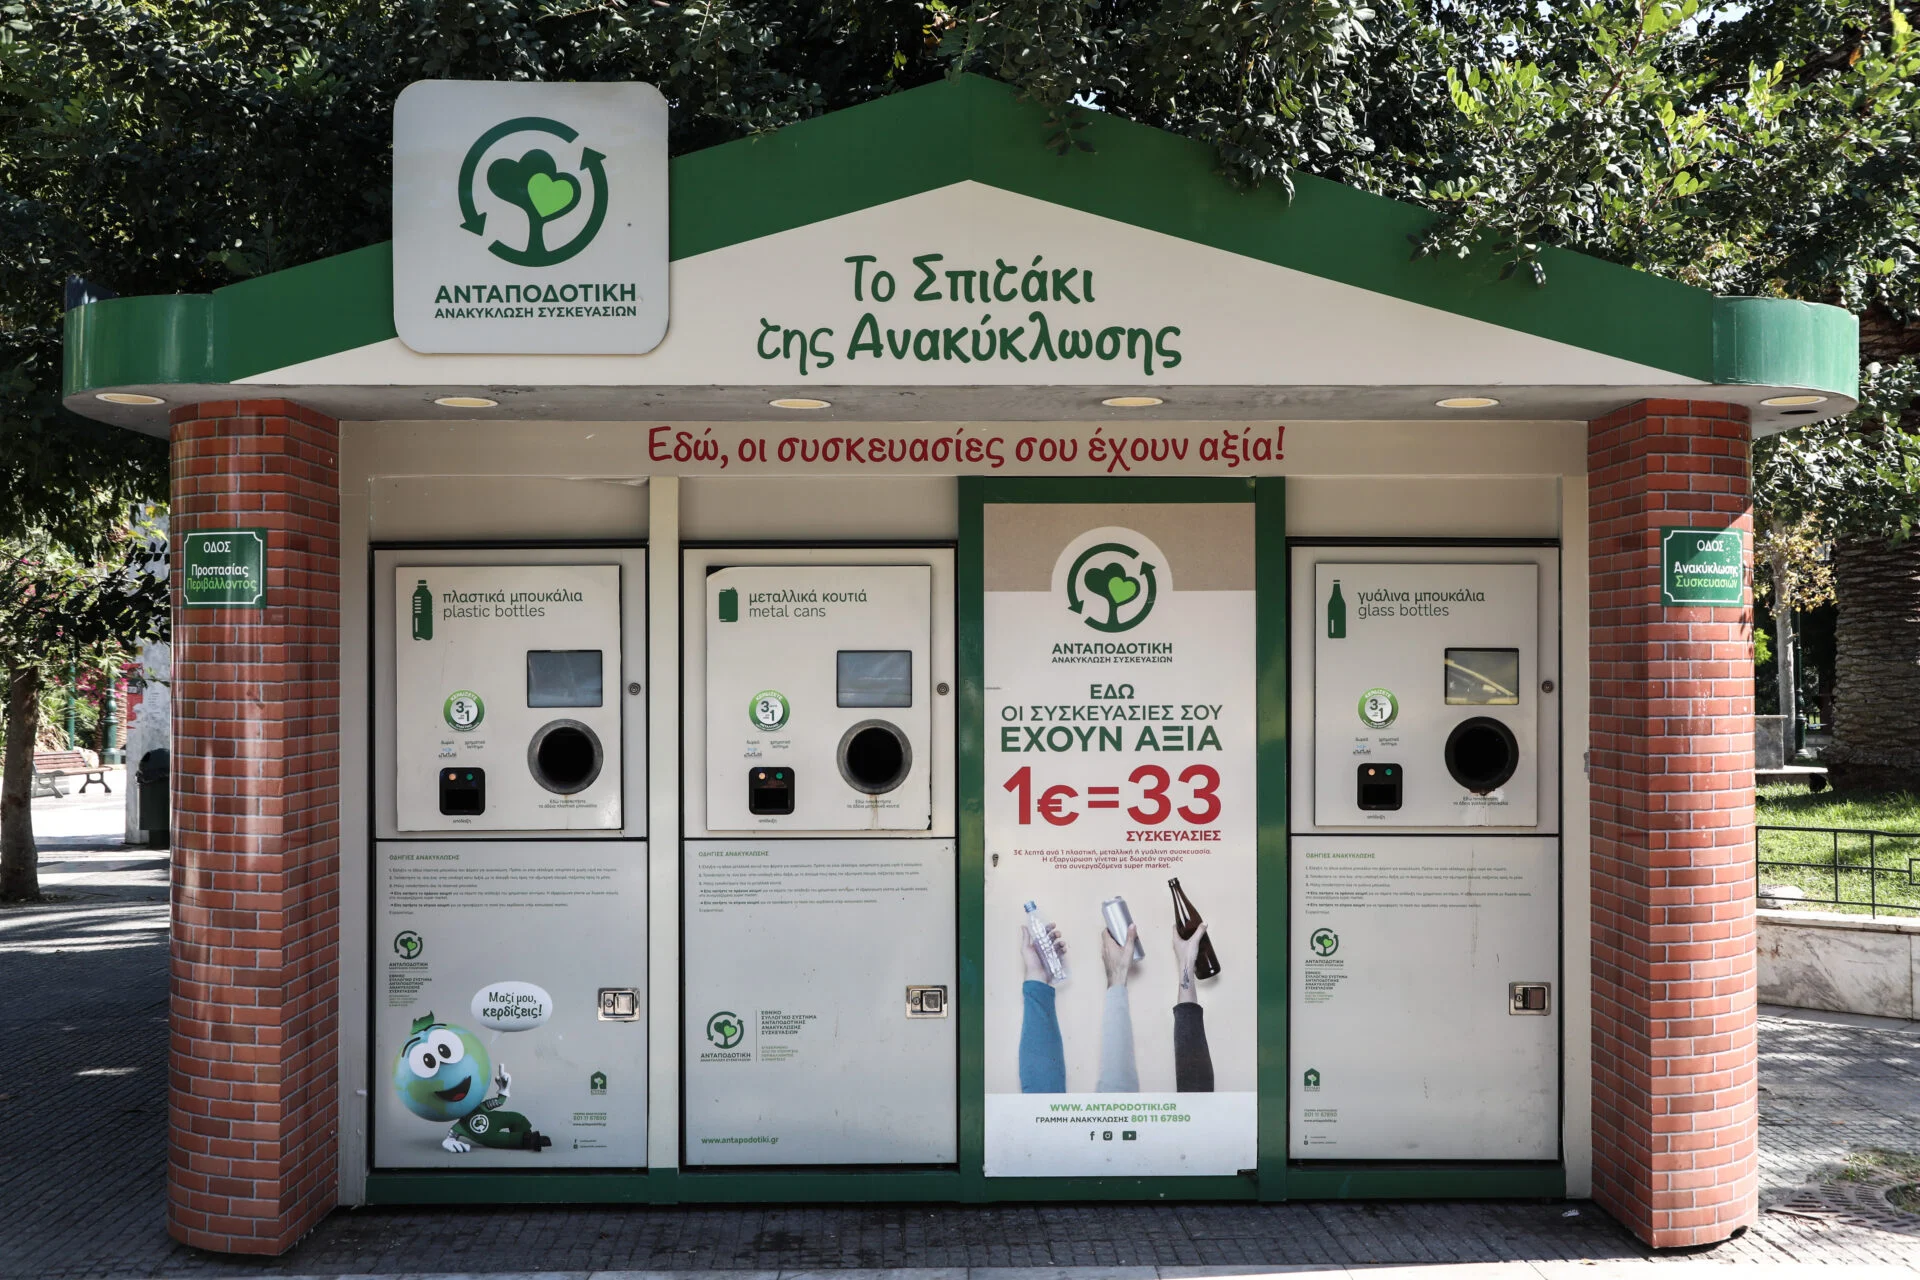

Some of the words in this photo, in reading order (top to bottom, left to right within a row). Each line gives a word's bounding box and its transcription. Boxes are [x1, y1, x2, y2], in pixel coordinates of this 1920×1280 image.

[845, 255, 895, 302] Το
[913, 253, 1095, 304] Σπιτάκι
[434, 284, 636, 304] ΑΝΤΑΠΟΔΟΤΙΚΗ
[434, 307, 534, 319] ΑΝΑΚΥΚΛΩΣΗ
[538, 306, 637, 318] ΣΥΣΚΕΥΑΣΙΩΝ
[757, 318, 835, 376] της
[847, 311, 1182, 376] Ανακύκλωσης
[648, 426, 729, 469] Εδώ,
[738, 438, 767, 462] οι
[777, 428, 1005, 468] συσκευασίες
[1016, 437, 1078, 462] σου
[1088, 427, 1189, 473] έχουν
[1199, 426, 1285, 468] αξία!
[204, 541, 231, 553] ΟΔΟΣ
[1697, 540, 1724, 552] ΟΔΟΣ
[192, 563, 248, 578] Προστασίας
[1674, 561, 1738, 578] Ανακύκλωσης
[187, 578, 256, 592] Περιβάλλοντος
[1676, 575, 1738, 588] Συσκευασιών
[443, 590, 505, 606] πλαστικά
[511, 589, 583, 606] μπουκάλια
[749, 589, 817, 606] μεταλλικά
[823, 588, 867, 603] κουτιά
[1358, 589, 1410, 606] γυάλινα
[1415, 588, 1485, 606] μπουκάλια
[443, 604, 490, 621] plastic
[495, 604, 545, 618] bottles
[749, 604, 789, 618] metal
[794, 608, 826, 618] cans
[1358, 604, 1395, 620] glass
[1400, 604, 1450, 617] bottles
[1052, 643, 1173, 655] ΑΝΤΑΠΟΔΟΤΙΚΗ
[1090, 684, 1135, 700] ΕΔΩ
[456, 701, 464, 713] 3
[761, 700, 770, 712] 3
[1370, 698, 1378, 710] 3
[465, 710, 470, 722] 1
[770, 710, 775, 721] 1
[1002, 706, 1023, 721] ΟΙ
[1031, 705, 1175, 721] ΣΥΣΚΕΥΑΣΙΕΣ
[1181, 705, 1222, 720] ΣΟΥ
[1379, 708, 1384, 719] 1
[1001, 726, 1123, 752] ΕΧΟΥΝ
[1135, 726, 1223, 752] ΑΞΙΑ
[1126, 830, 1222, 842] ΣΥΣΚΕΥΑΣΙΕΣ
[1141, 848, 1168, 857] γυάλινη
[1130, 856, 1156, 864] δωρεάν
[1158, 856, 1184, 864] αγορές
[489, 992, 514, 1004] Μαζί
[516, 995, 536, 1005] μου,
[482, 1004, 542, 1020] κερδίζεις!
[1086, 1103, 1176, 1111] ANTAPODOTIKI.GR
[700, 1136, 778, 1145] www.antapodotiki.gr
